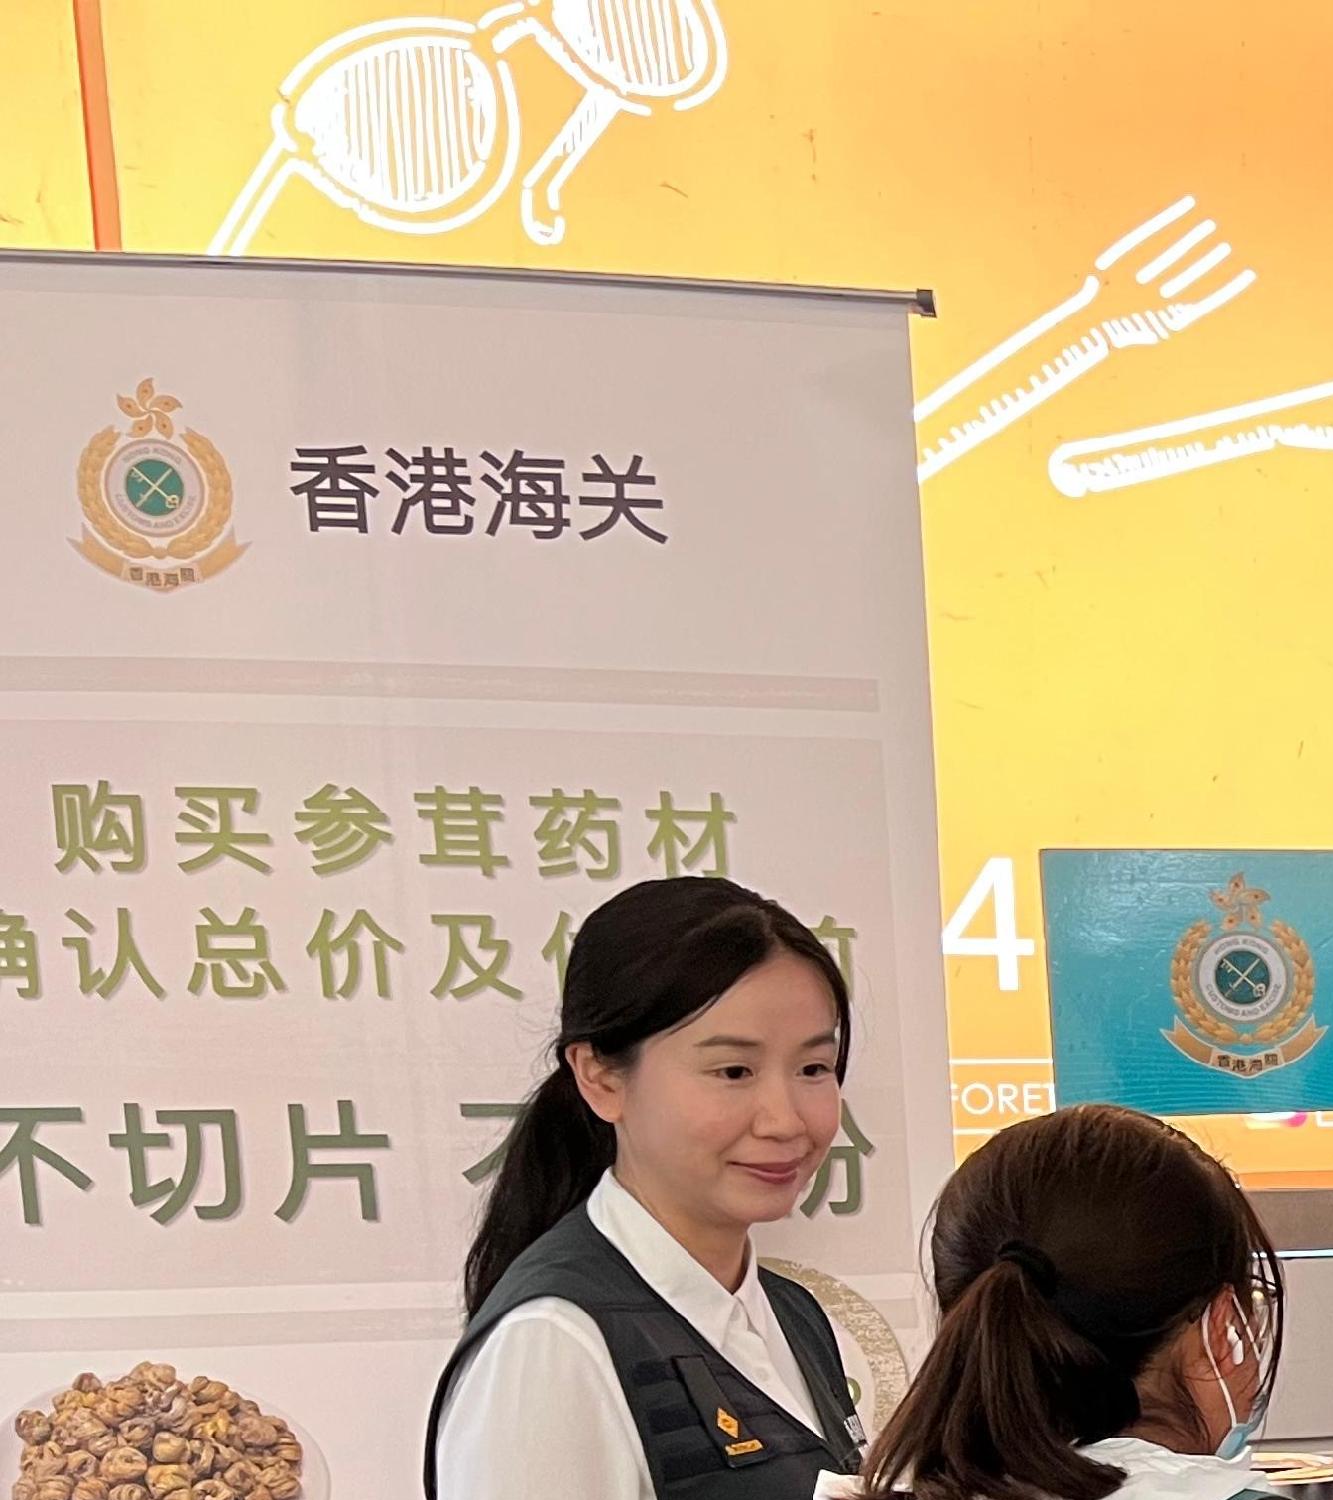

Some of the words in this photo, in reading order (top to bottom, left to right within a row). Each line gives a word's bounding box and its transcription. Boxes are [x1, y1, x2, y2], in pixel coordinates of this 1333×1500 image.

[290, 444, 669, 545] 香港海关
[51, 779, 738, 880] 购买参茸药材
[0, 907, 857, 1000] 认总价及
[942, 857, 1034, 991] 4
[0, 1099, 389, 1226] 不切片
